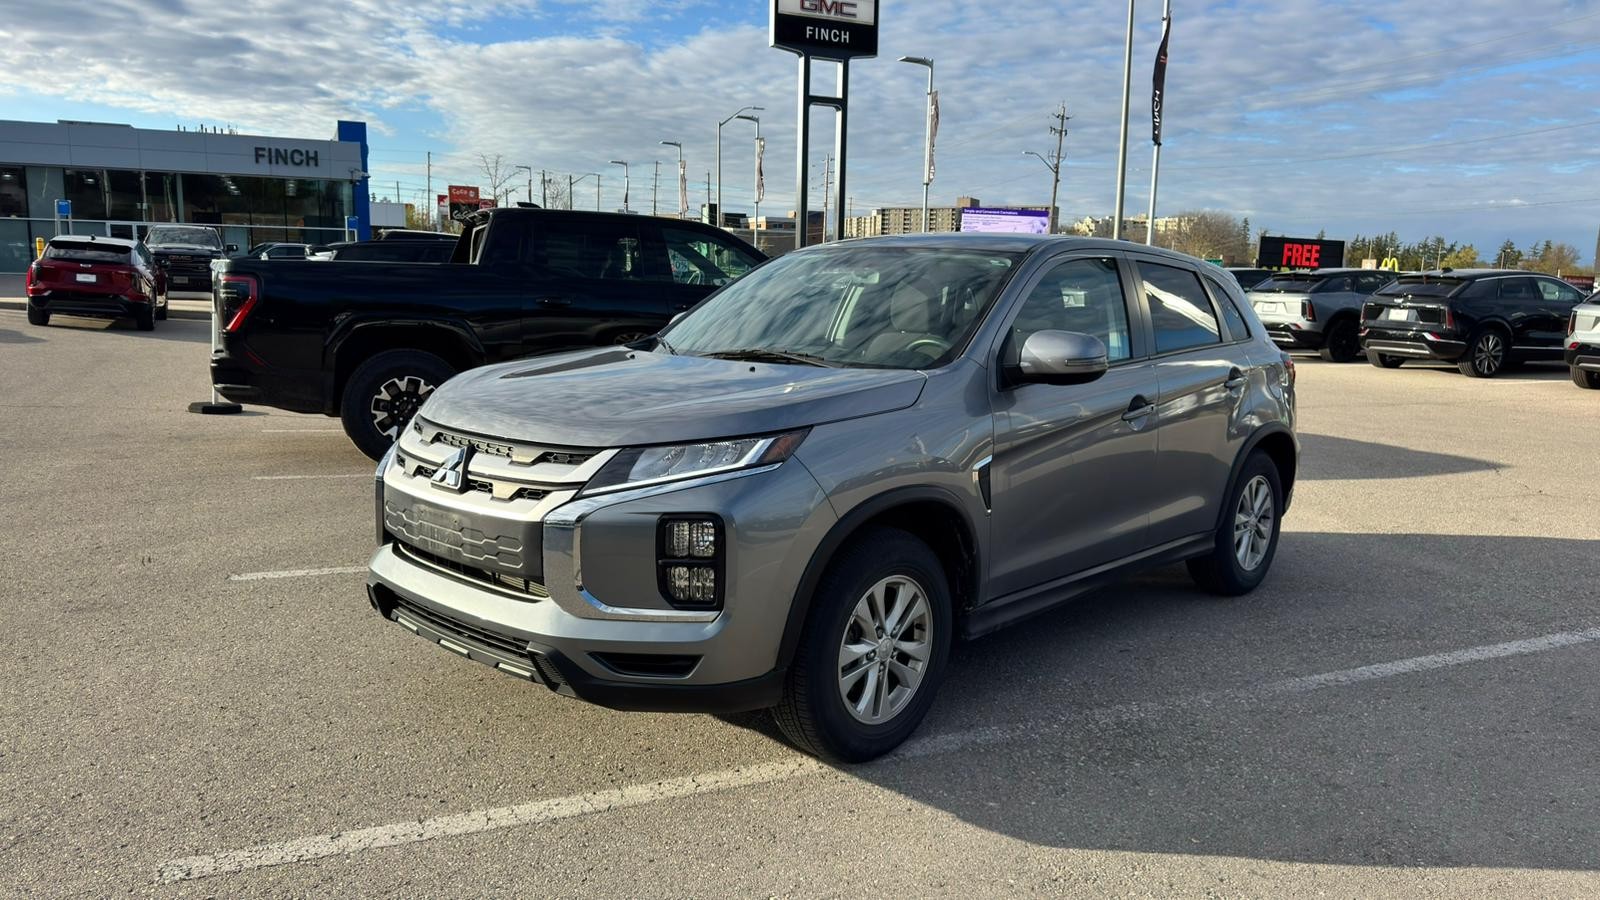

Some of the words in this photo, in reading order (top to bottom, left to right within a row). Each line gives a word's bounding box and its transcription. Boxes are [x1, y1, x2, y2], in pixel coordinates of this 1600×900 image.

[800, 0, 857, 18] GMC
[806, 26, 849, 43] FINCH
[254, 147, 319, 167] FINCH
[1282, 243, 1320, 267] FREE
